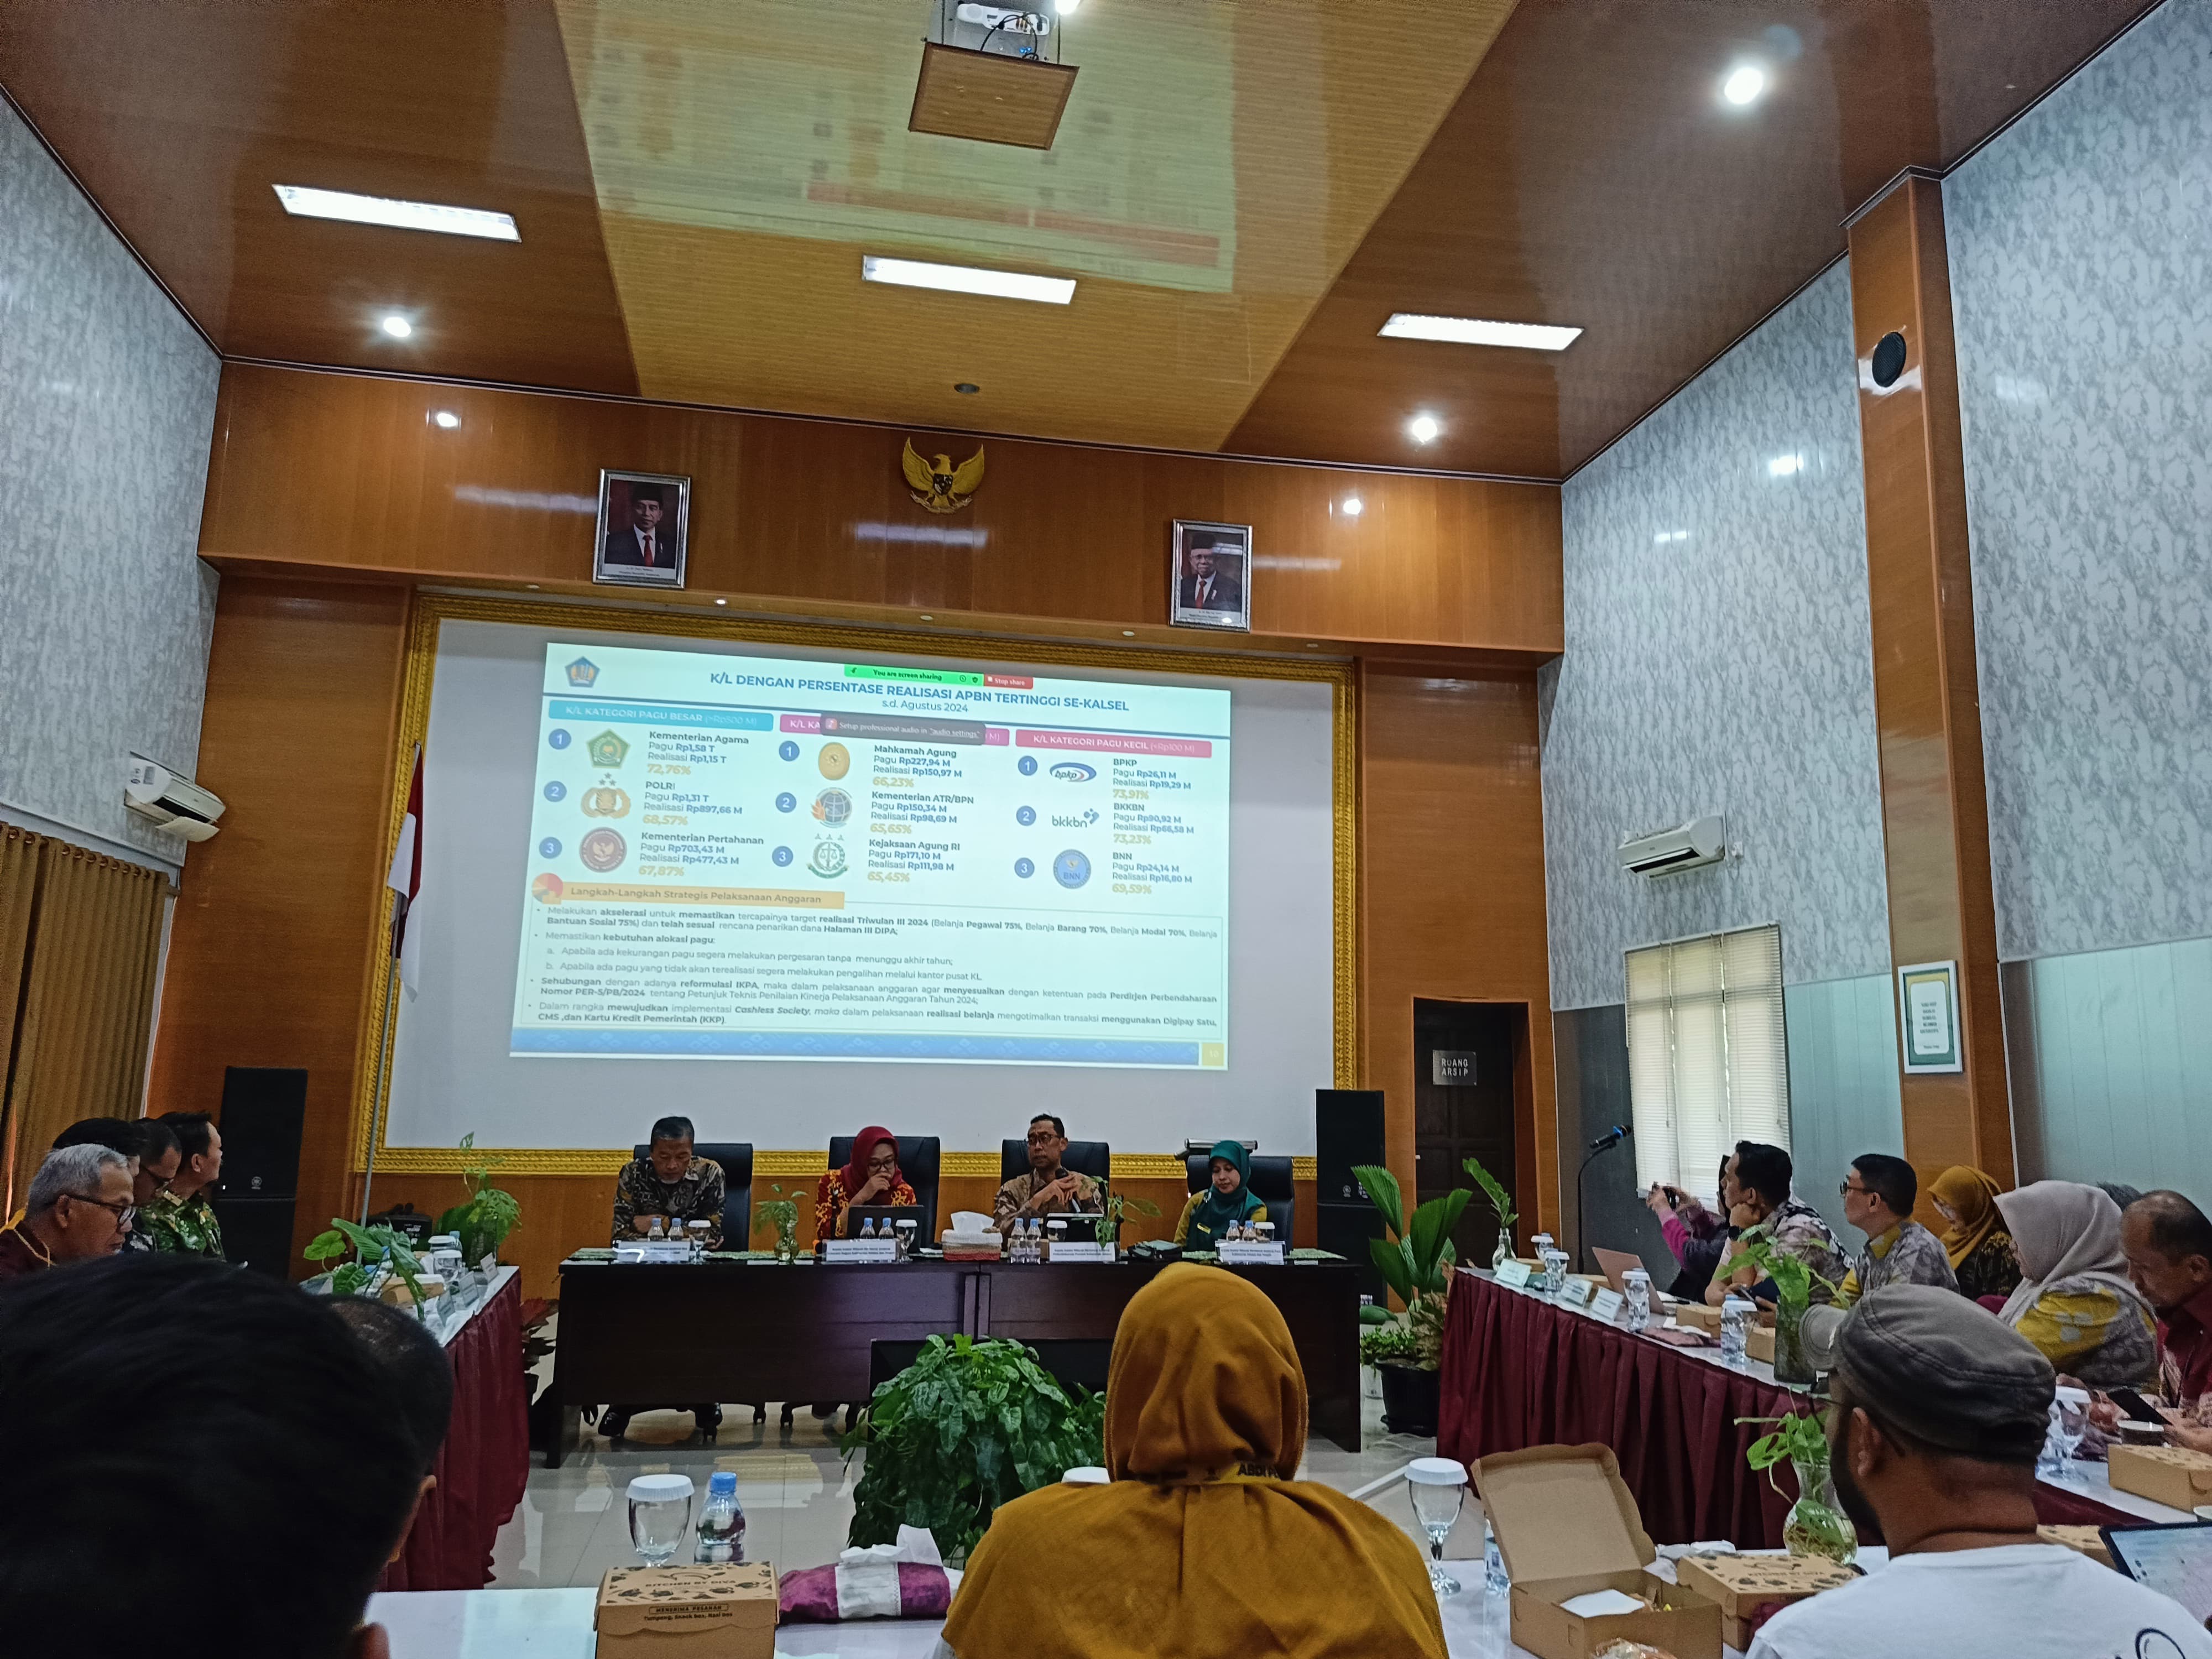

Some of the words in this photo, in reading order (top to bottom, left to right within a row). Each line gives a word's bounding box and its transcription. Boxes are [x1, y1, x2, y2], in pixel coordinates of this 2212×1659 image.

[919, 673, 942, 681] sharing
[711, 673, 732, 685] K/L
[736, 675, 794, 689] DENGAN
[798, 679, 883, 695] PERSENTASE
[886, 685, 951, 700] REALISASI
[955, 690, 991, 702] APBN
[995, 692, 1060, 707] TERTINGGI
[1063, 697, 1129, 711] SE-KALSEL
[900, 701, 941, 711] Agustus
[944, 703, 968, 712] 2024
[585, 707, 636, 717] KATEGORI
[669, 712, 702, 721] BESAR
[557, 734, 562, 744] 1
[650, 731, 712, 741] Kementerian
[714, 734, 749, 743] Agama
[1050, 736, 1094, 745] KATEGORI
[1097, 738, 1121, 747] PAGU
[649, 743, 673, 752] Pagu
[675, 744, 707, 753] Rp1,58
[786, 747, 792, 757] 1
[874, 745, 924, 754] Mahkamah
[926, 748, 957, 758] Agung
[648, 752, 689, 761] Realisasi
[688, 754, 718, 763] Rp1,15
[874, 756, 896, 765] Pagu
[899, 757, 940, 766] Rp227,94
[647, 764, 691, 775] 72,76%
[873, 765, 910, 774] Realisasi
[912, 767, 951, 776] Rp150,97
[1025, 761, 1030, 771] 1
[1055, 770, 1077, 780] bpkp
[1113, 769, 1135, 778] Pagu
[1136, 770, 1166, 779] Rp26,11
[645, 781, 675, 790] POLRI
[872, 776, 914, 787] 66,23%
[1113, 778, 1148, 786] Realisasi
[1149, 780, 1181, 789] Rp19,29
[551, 787, 559, 796] 2
[1113, 789, 1149, 800] 73,91%
[645, 793, 669, 802] Pagu
[672, 794, 700, 803] Rp1,31
[782, 798, 790, 807] 2
[872, 791, 931, 801] Kementerian
[932, 794, 974, 804] ATR/BPN
[644, 802, 684, 811] Realisasi
[686, 804, 731, 813] Rp897,66
[872, 802, 894, 811] Pagu
[896, 803, 936, 812] Rp150,34
[1114, 802, 1144, 811] BKKBN
[642, 815, 688, 825] 68,57%
[871, 812, 907, 820] Realisasi
[910, 813, 947, 822] Rp98,69
[1022, 811, 1030, 821] 2
[1052, 815, 1087, 827] bkkbn
[1113, 813, 1136, 822] Pagu
[1137, 813, 1171, 823] Rp90,92
[870, 823, 911, 833] 65,65%
[1113, 822, 1149, 831] Realisasi
[1150, 824, 1184, 833] Rp66,58
[641, 832, 705, 842] Kementerian
[708, 834, 764, 843] Pertahanan
[1113, 834, 1151, 844] 73,23%
[546, 843, 554, 853] 3
[640, 843, 665, 853] Pagu
[668, 844, 713, 853] Rp703,43
[869, 839, 916, 849] Kejaksaan
[918, 842, 948, 851] Agung
[640, 853, 680, 862] Realisasi
[682, 855, 728, 864] Rp477,43
[779, 852, 786, 862] 3
[869, 850, 891, 859] Pagu
[894, 851, 930, 860] Rp171,10
[868, 859, 905, 868] Realisasi
[907, 861, 943, 870] Rp111,98
[1021, 863, 1027, 873] 3
[1112, 863, 1134, 872] Pagu
[1136, 863, 1170, 872] Rp24,14
[638, 866, 684, 875] 67,87%
[867, 871, 910, 881] 65,45%
[1112, 872, 1148, 880] Realisasi
[1150, 873, 1182, 883] Rp16,80
[1112, 884, 1151, 894] 69,59%
[571, 886, 661, 898] Langkah-Langkah
[664, 890, 708, 900] Strategis
[711, 891, 771, 900] Pelaksanaan
[774, 893, 821, 903] Anggaran
[1442, 1058, 1468, 1067] RUANG
[1442, 1068, 1468, 1076] ARSIP
